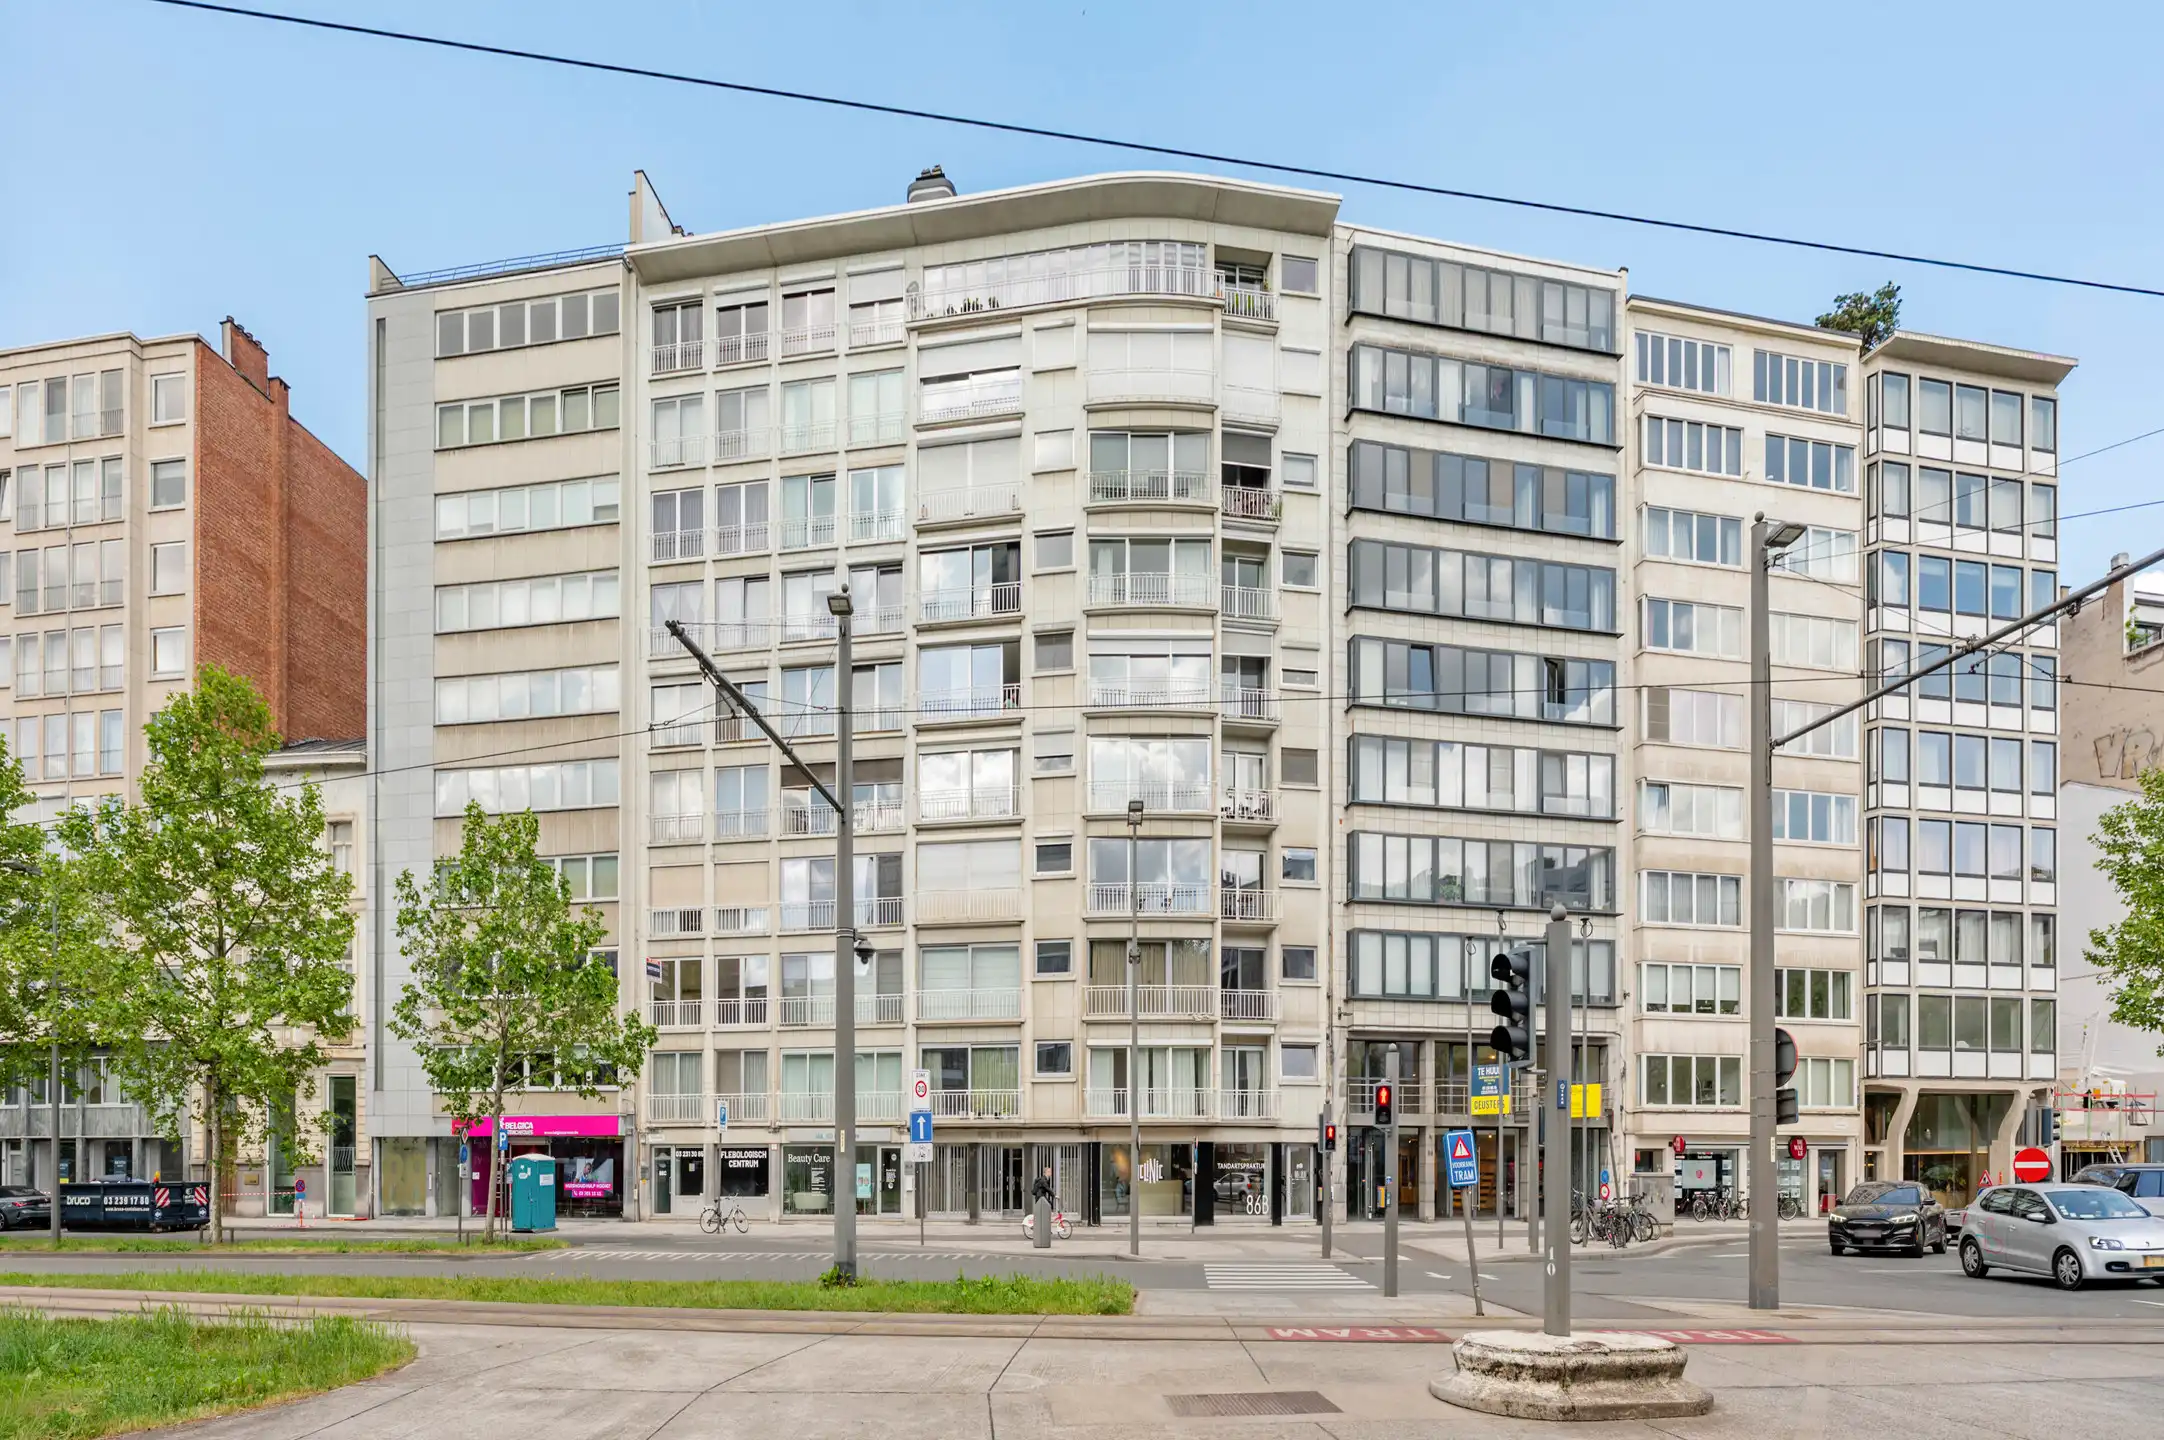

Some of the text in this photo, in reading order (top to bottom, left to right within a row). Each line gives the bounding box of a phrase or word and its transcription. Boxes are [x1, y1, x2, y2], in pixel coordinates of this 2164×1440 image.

[1478, 1067, 1485, 1076] TE
[505, 1121, 534, 1130] BELGICA
[720, 1150, 767, 1159] FLEBOLOGISCH
[788, 1153, 831, 1165] Beauty Care
[728, 1160, 759, 1168] CENTRUM
[1452, 1160, 1475, 1169] VOORRANG
[1454, 1170, 1475, 1181] TRAM
[67, 1195, 91, 1205] bruco
[103, 1196, 149, 1205] 03 239 17 80
[1246, 1194, 1269, 1215] 86B
[1273, 1328, 1438, 1338] TRAM
